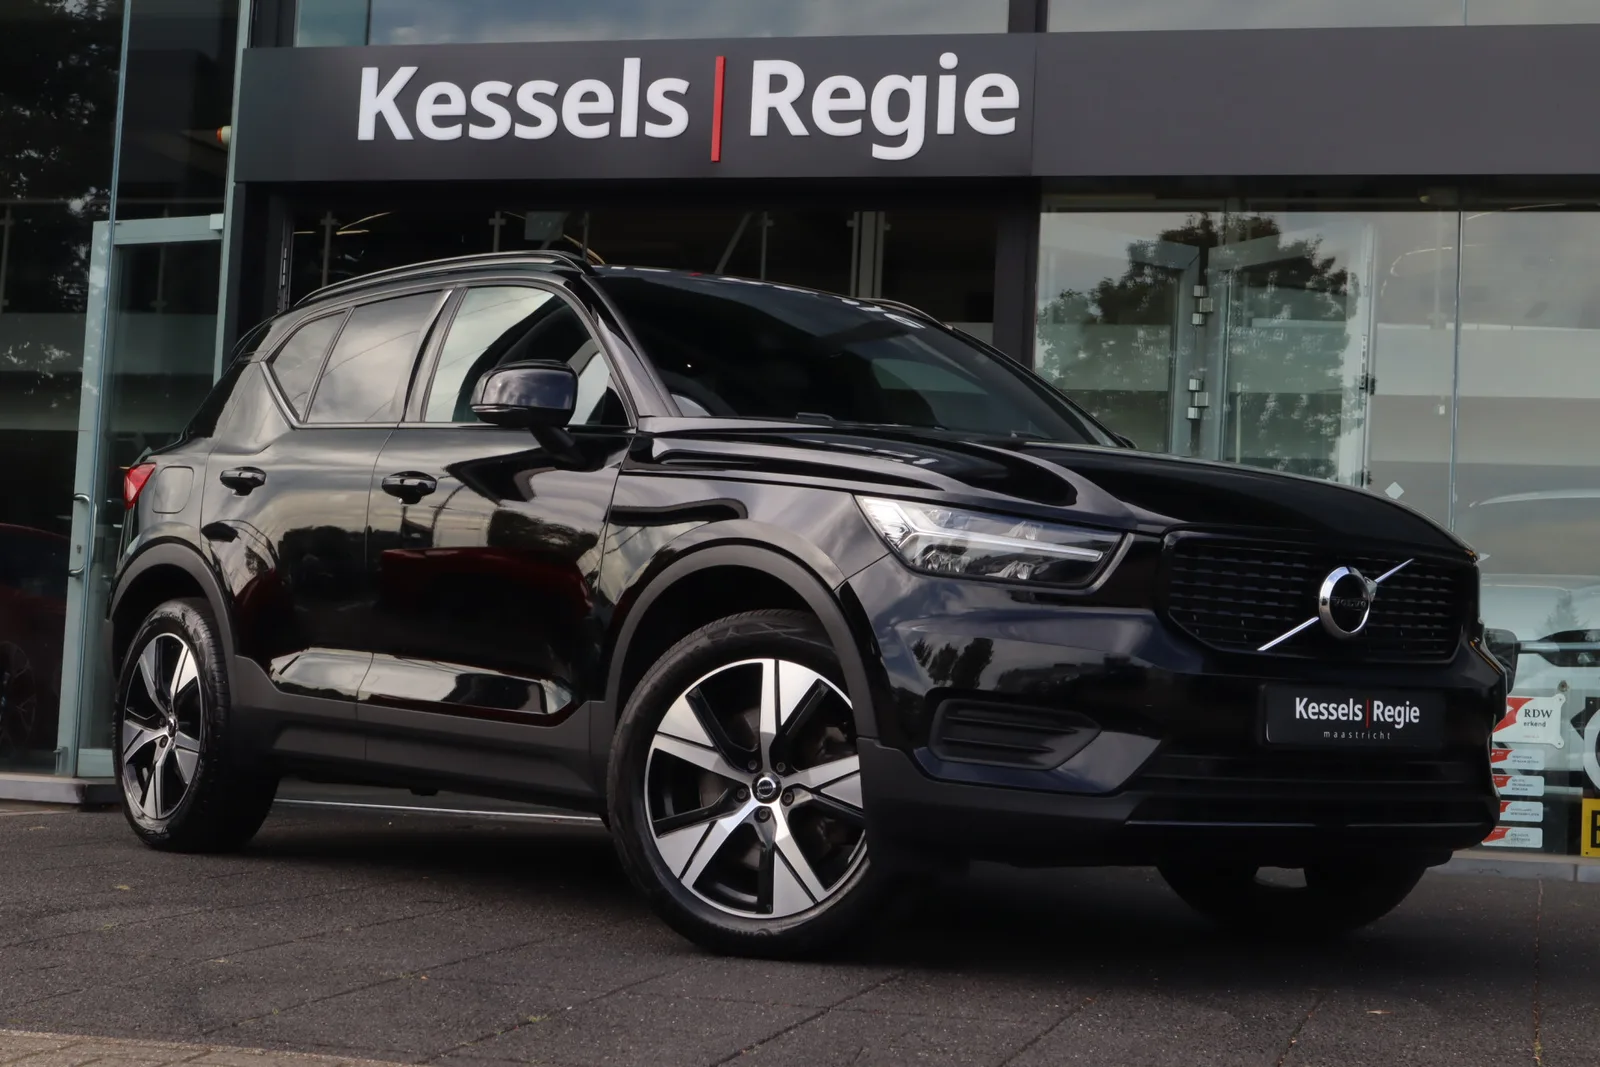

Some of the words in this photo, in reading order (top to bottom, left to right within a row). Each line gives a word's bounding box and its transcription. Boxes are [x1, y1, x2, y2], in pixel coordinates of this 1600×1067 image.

[357, 57, 690, 141] Kessels
[749, 52, 1020, 160] Regie
[1295, 697, 1363, 721] Kessels
[1373, 700, 1420, 729] Regie
[1524, 708, 1553, 718] RDW
[1323, 731, 1391, 740] maastricht
